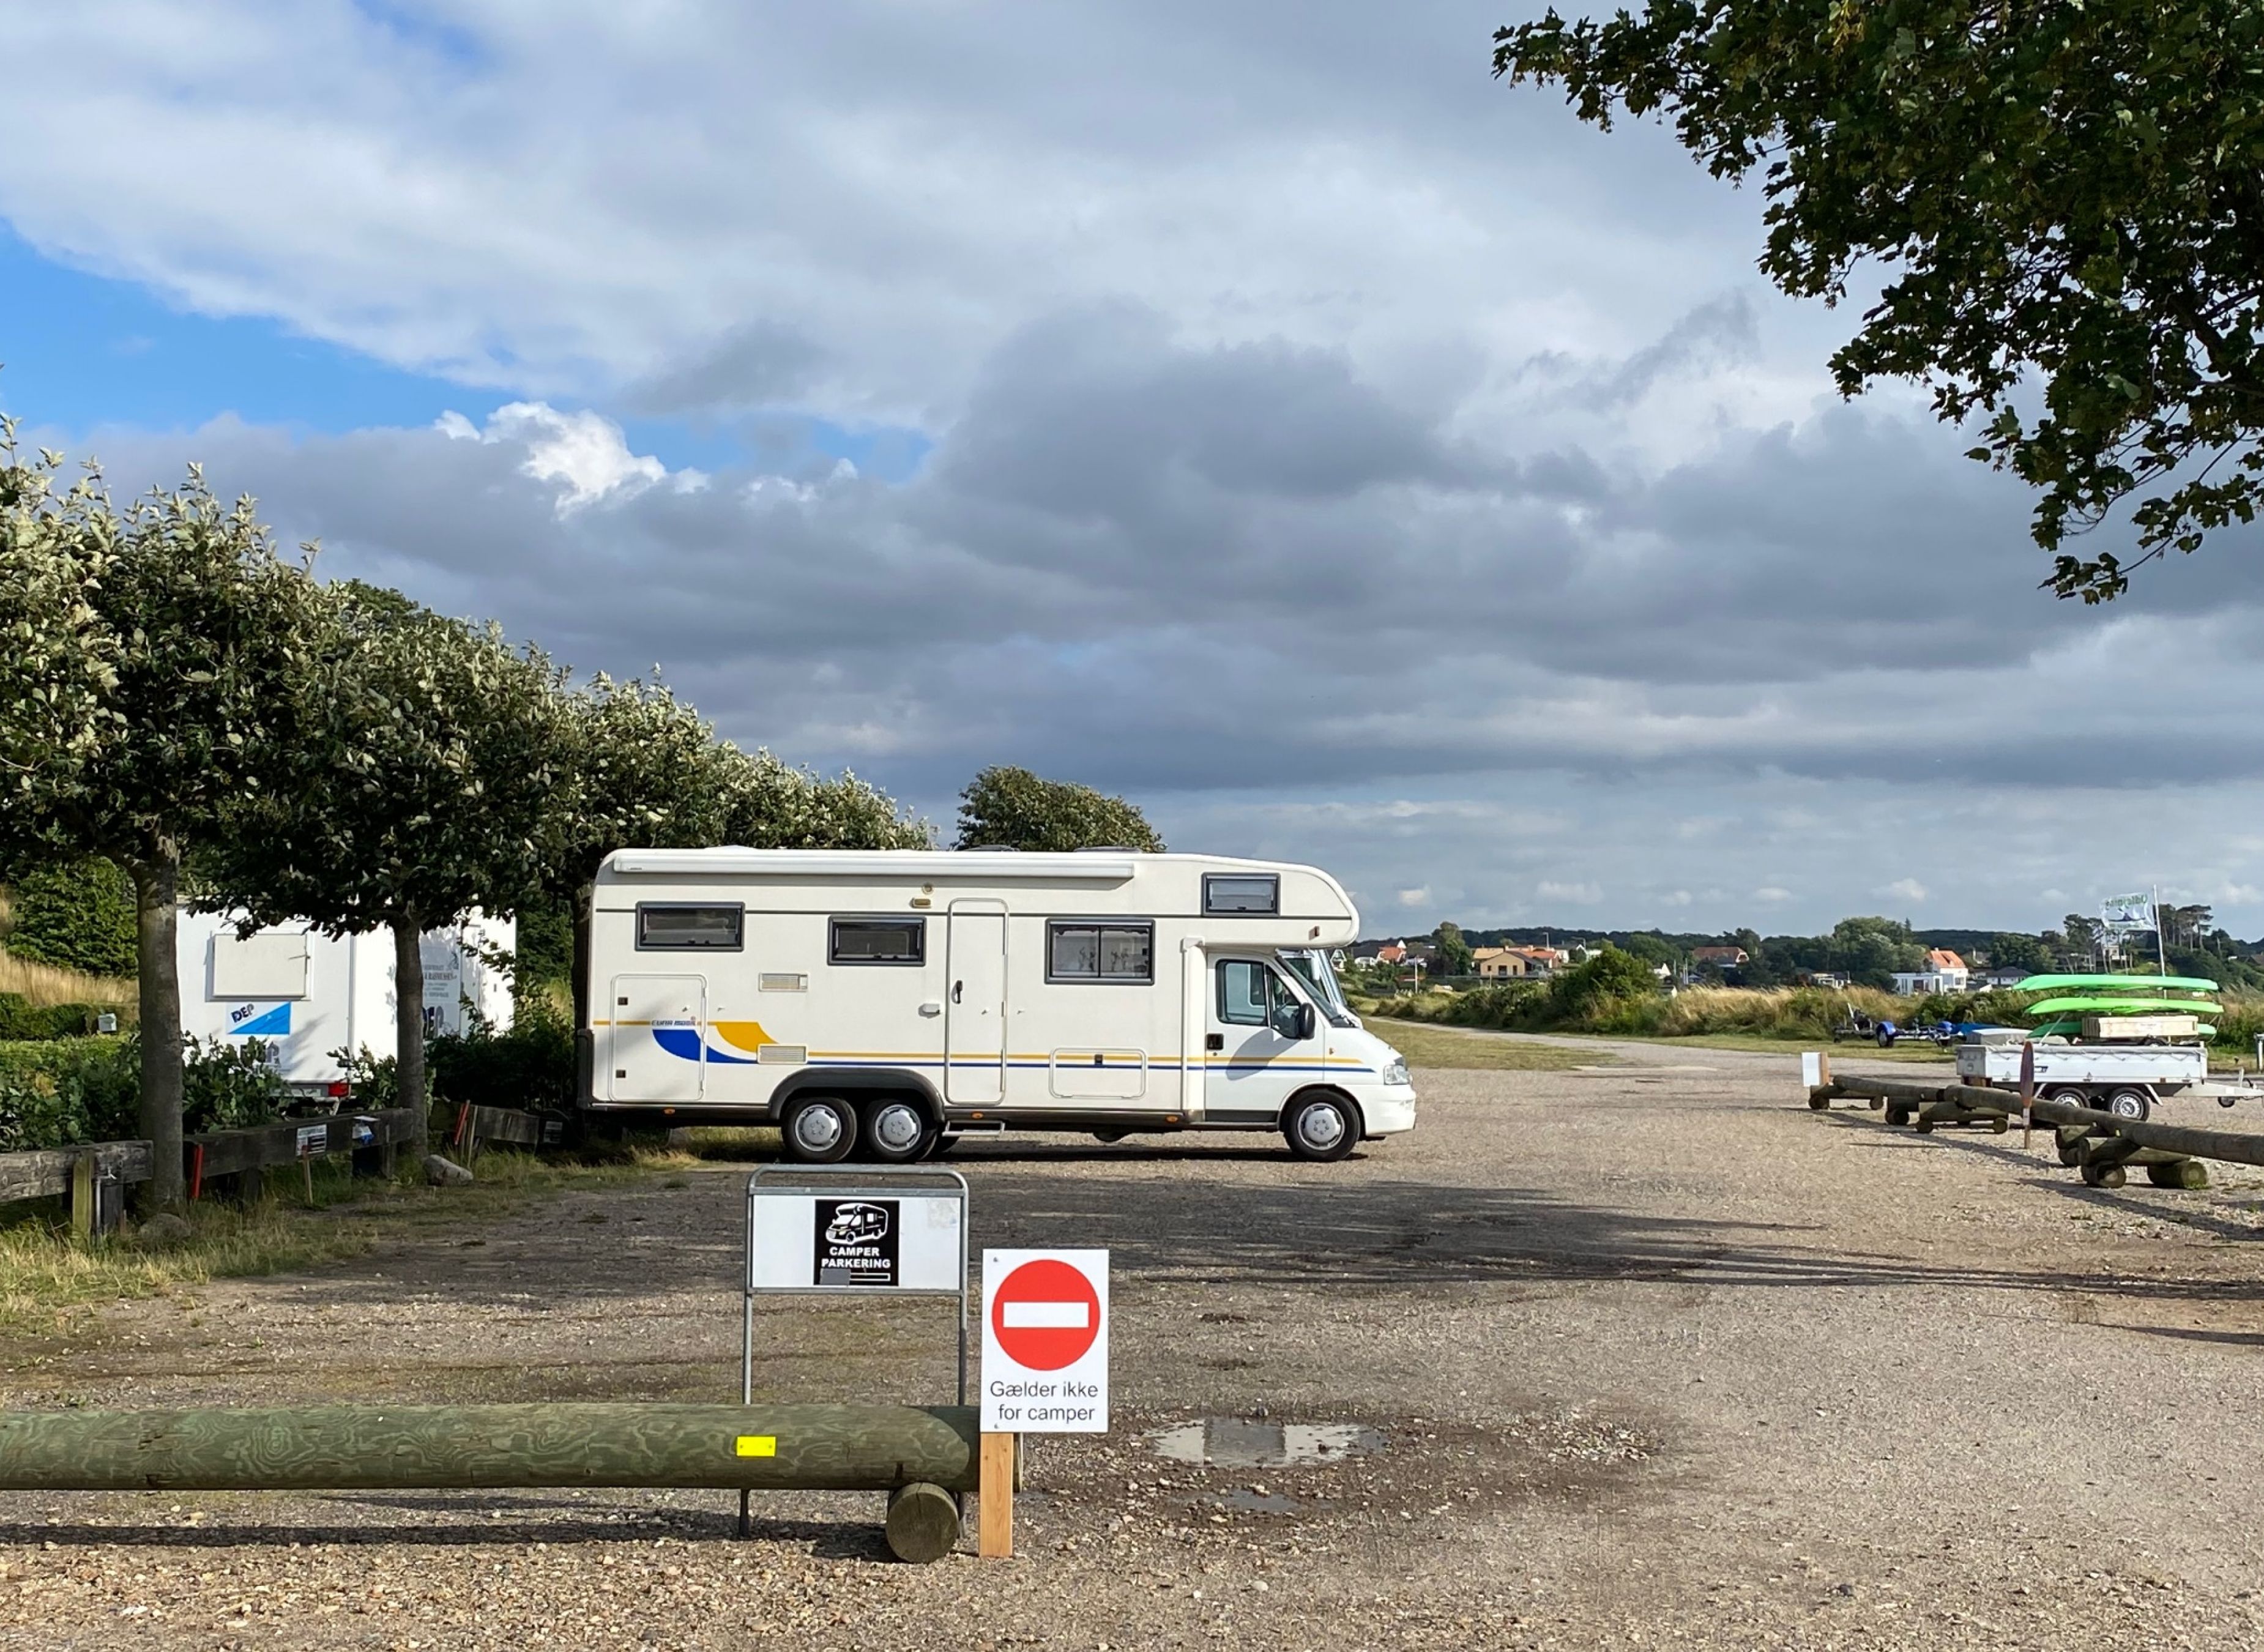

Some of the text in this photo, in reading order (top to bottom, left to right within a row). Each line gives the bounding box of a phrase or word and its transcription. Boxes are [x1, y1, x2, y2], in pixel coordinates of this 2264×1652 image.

[829, 1246, 880, 1256] CAMPER
[821, 1258, 892, 1268] PARKERING
[990, 1380, 1099, 1397] Gælder ikke
[999, 1404, 1095, 1424] for camper
